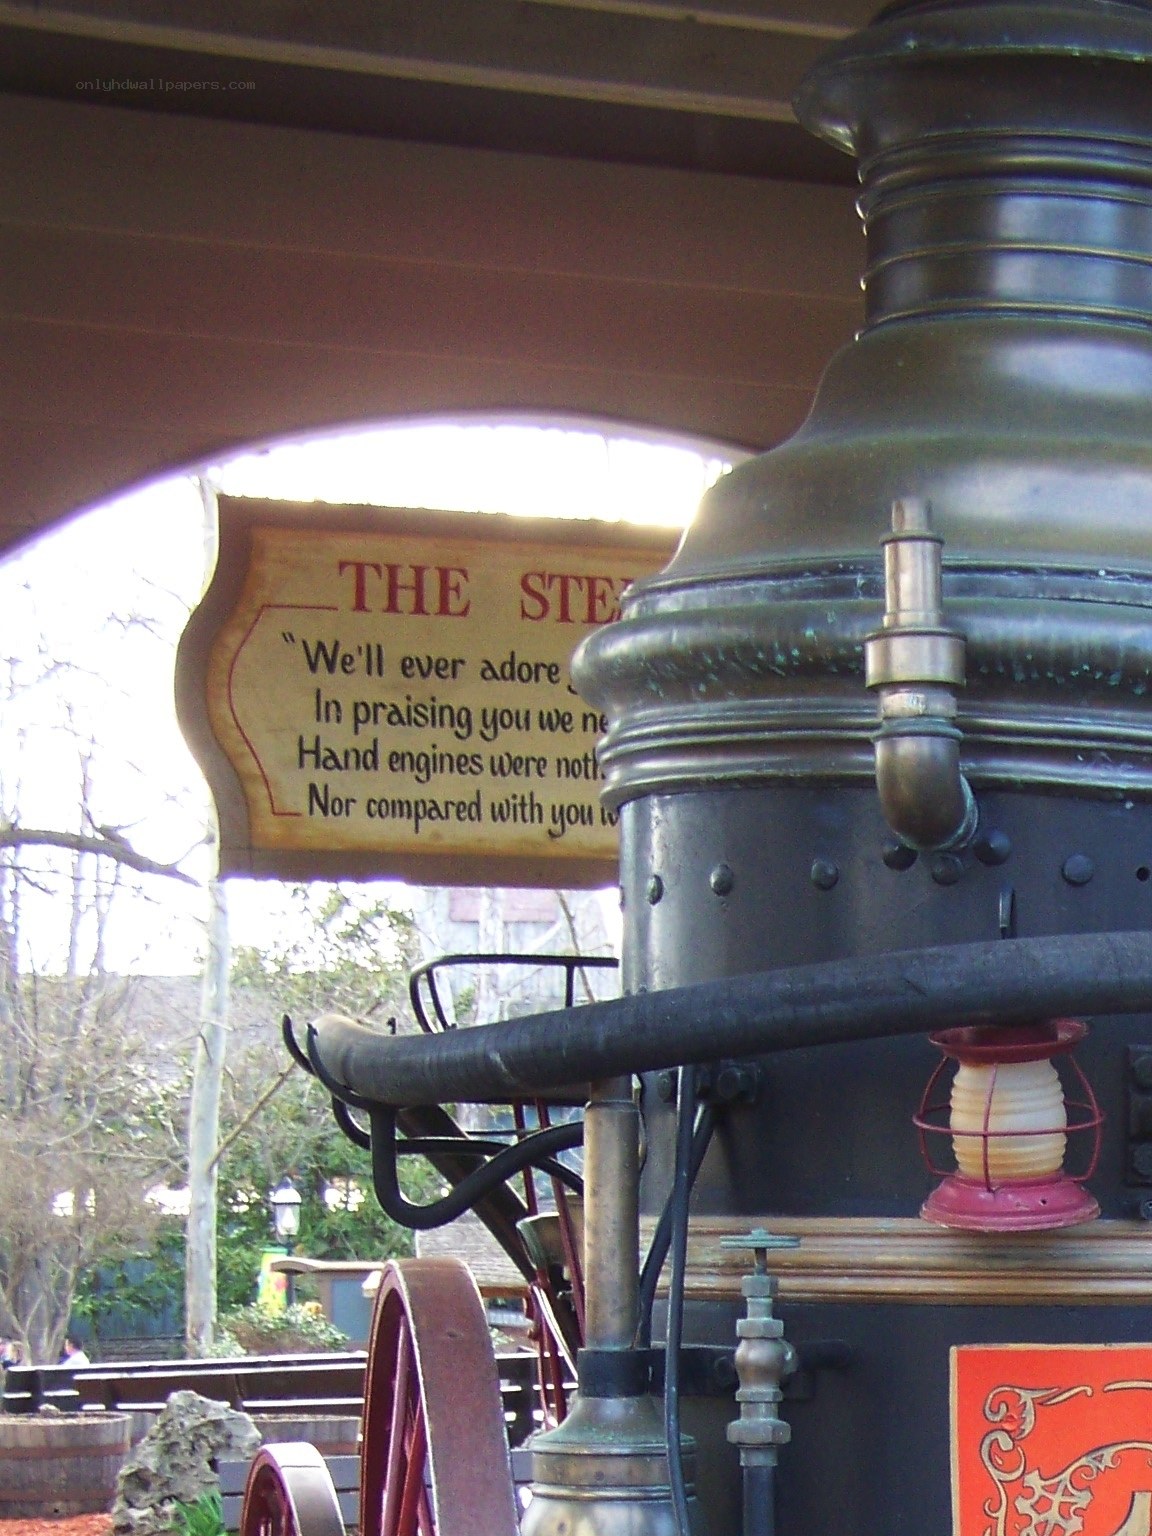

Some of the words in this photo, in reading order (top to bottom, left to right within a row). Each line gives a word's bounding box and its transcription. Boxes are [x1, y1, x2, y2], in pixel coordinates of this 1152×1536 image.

[339, 561, 471, 618] THE
[401, 655, 466, 680] ever
[480, 651, 561, 685] adore
[315, 687, 342, 725] In
[353, 694, 473, 740] praising
[479, 707, 531, 742] you
[539, 708, 574, 733] we
[298, 735, 379, 772] Hand
[388, 743, 484, 784] engines
[490, 752, 547, 779] were
[308, 782, 357, 818] Nor
[366, 789, 482, 834] compared
[491, 791, 544, 825] with
[547, 803, 594, 839] you
